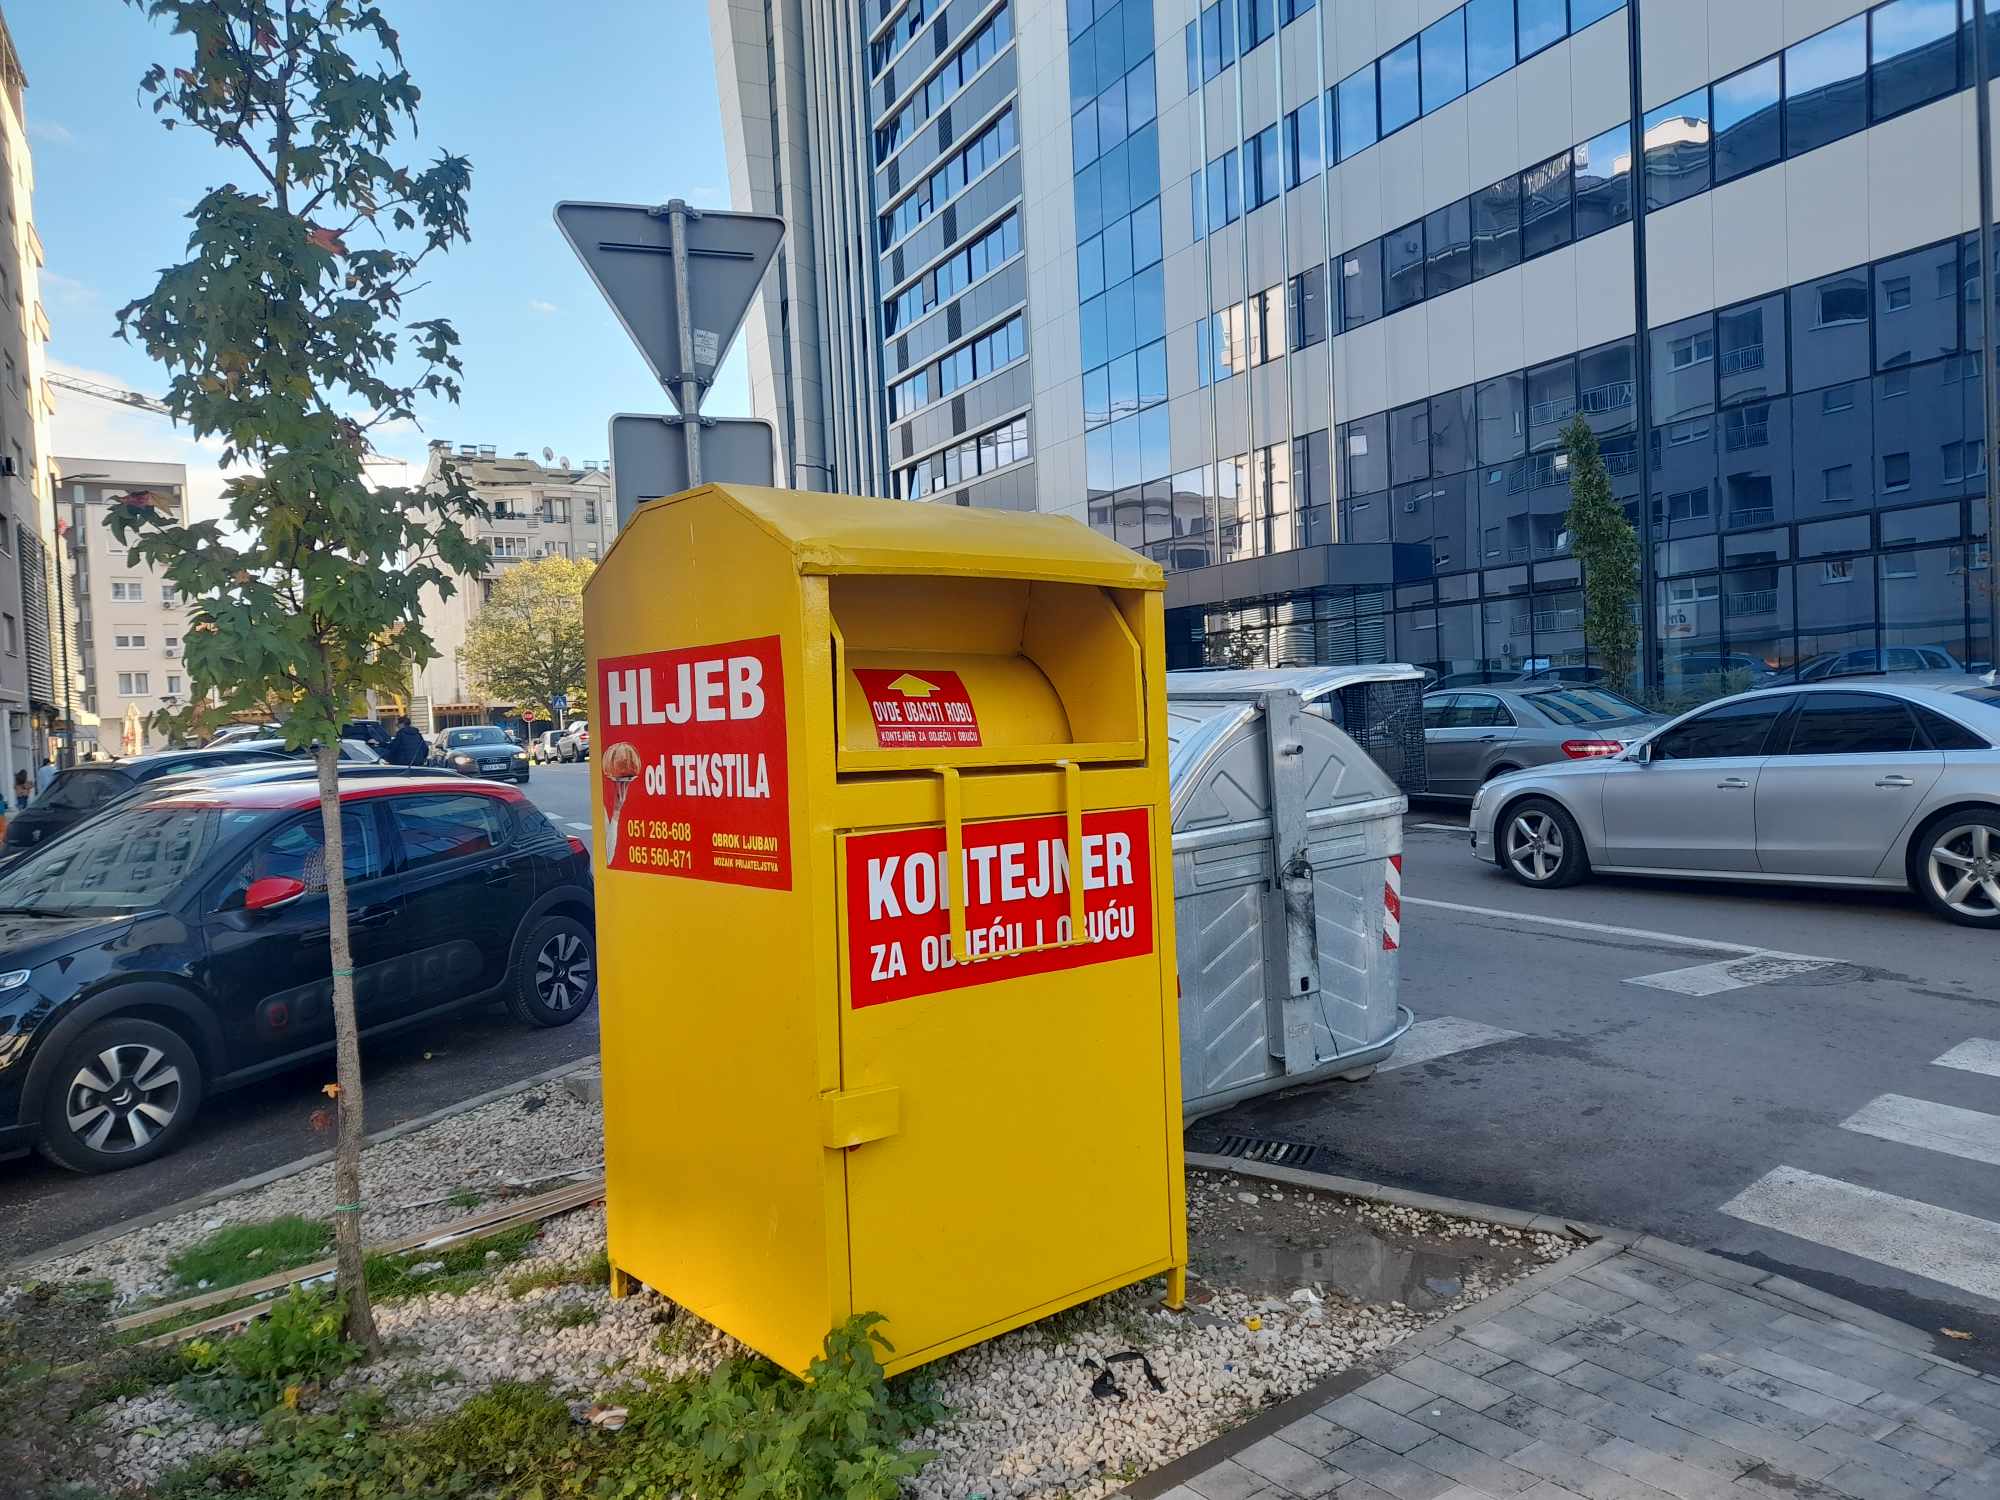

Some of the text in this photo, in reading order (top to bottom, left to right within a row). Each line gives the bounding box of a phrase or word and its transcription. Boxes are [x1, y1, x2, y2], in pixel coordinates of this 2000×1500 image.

[607, 655, 765, 726] HLJEB
[873, 701, 973, 723] OVDE UBACITI ROBU
[918, 731, 927, 742] ZA
[645, 752, 771, 799] od TEKSTILA
[627, 819, 691, 842] 051 268-608
[712, 832, 778, 852] OBROK LJUBAVI
[629, 845, 692, 870] 065 560-871
[713, 856, 779, 873] MOZAIK PRIJATELJSTVA
[870, 941, 907, 982] ZA
[921, 916, 1024, 972] ODJEĆU
[1036, 919, 1044, 952] I
